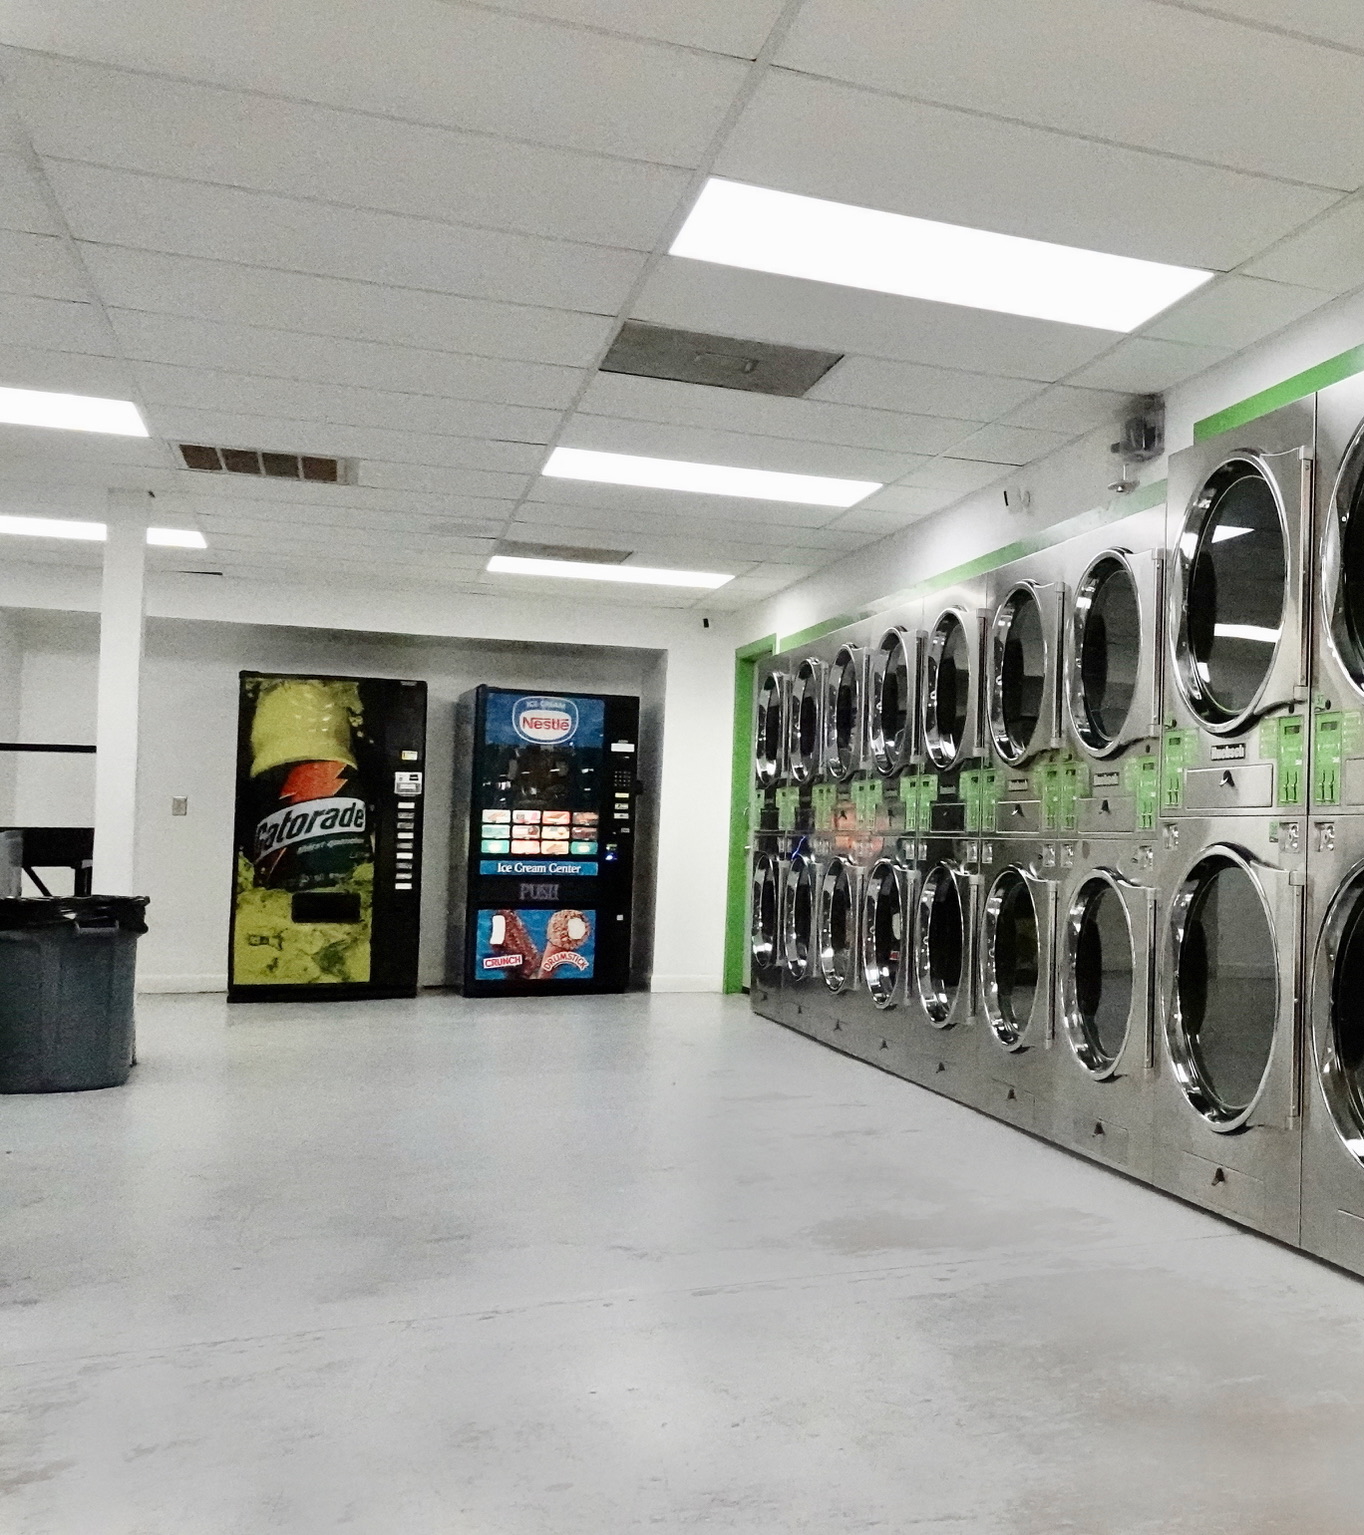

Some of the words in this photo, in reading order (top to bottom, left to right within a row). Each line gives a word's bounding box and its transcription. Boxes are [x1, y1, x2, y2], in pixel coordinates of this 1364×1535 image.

[497, 863, 512, 873] Ice
[514, 863, 547, 873] Cream
[548, 863, 582, 873] Center
[520, 883, 559, 900] PUSH
[484, 956, 521, 967] CRUNCH
[544, 953, 588, 970] DRUMSTICK
